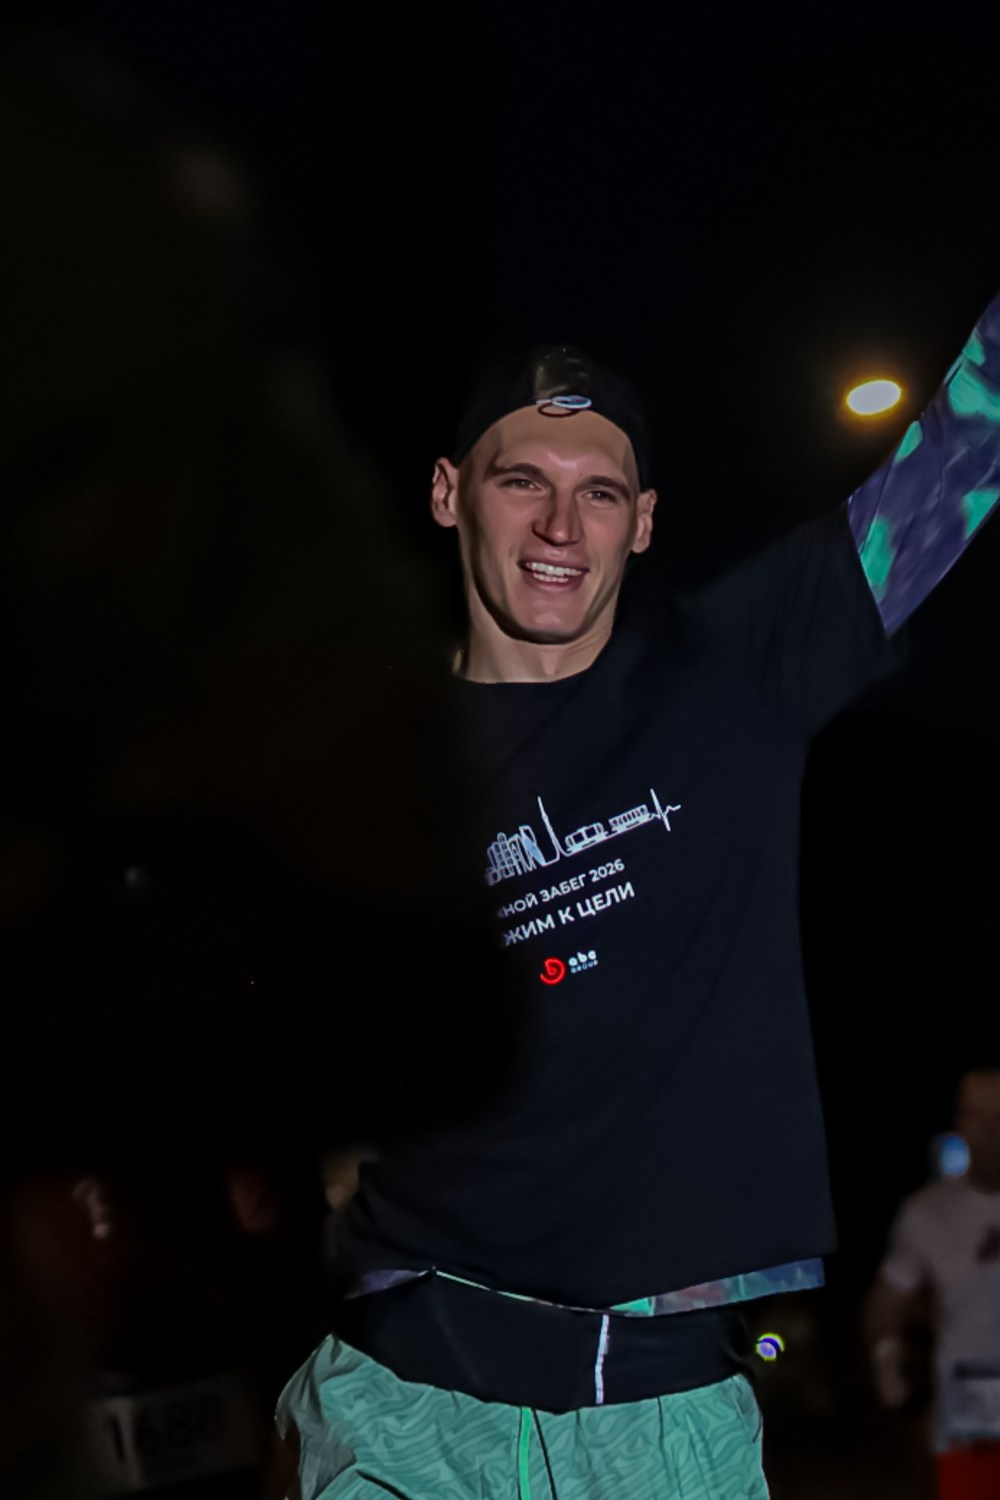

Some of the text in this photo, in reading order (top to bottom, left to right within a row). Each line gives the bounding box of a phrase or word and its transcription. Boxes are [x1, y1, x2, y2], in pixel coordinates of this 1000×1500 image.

[497, 858, 625, 918] НОЙ ЗАБЕГ 2026
[557, 906, 576, 926] К
[576, 881, 636, 918] ЦЕЛИ
